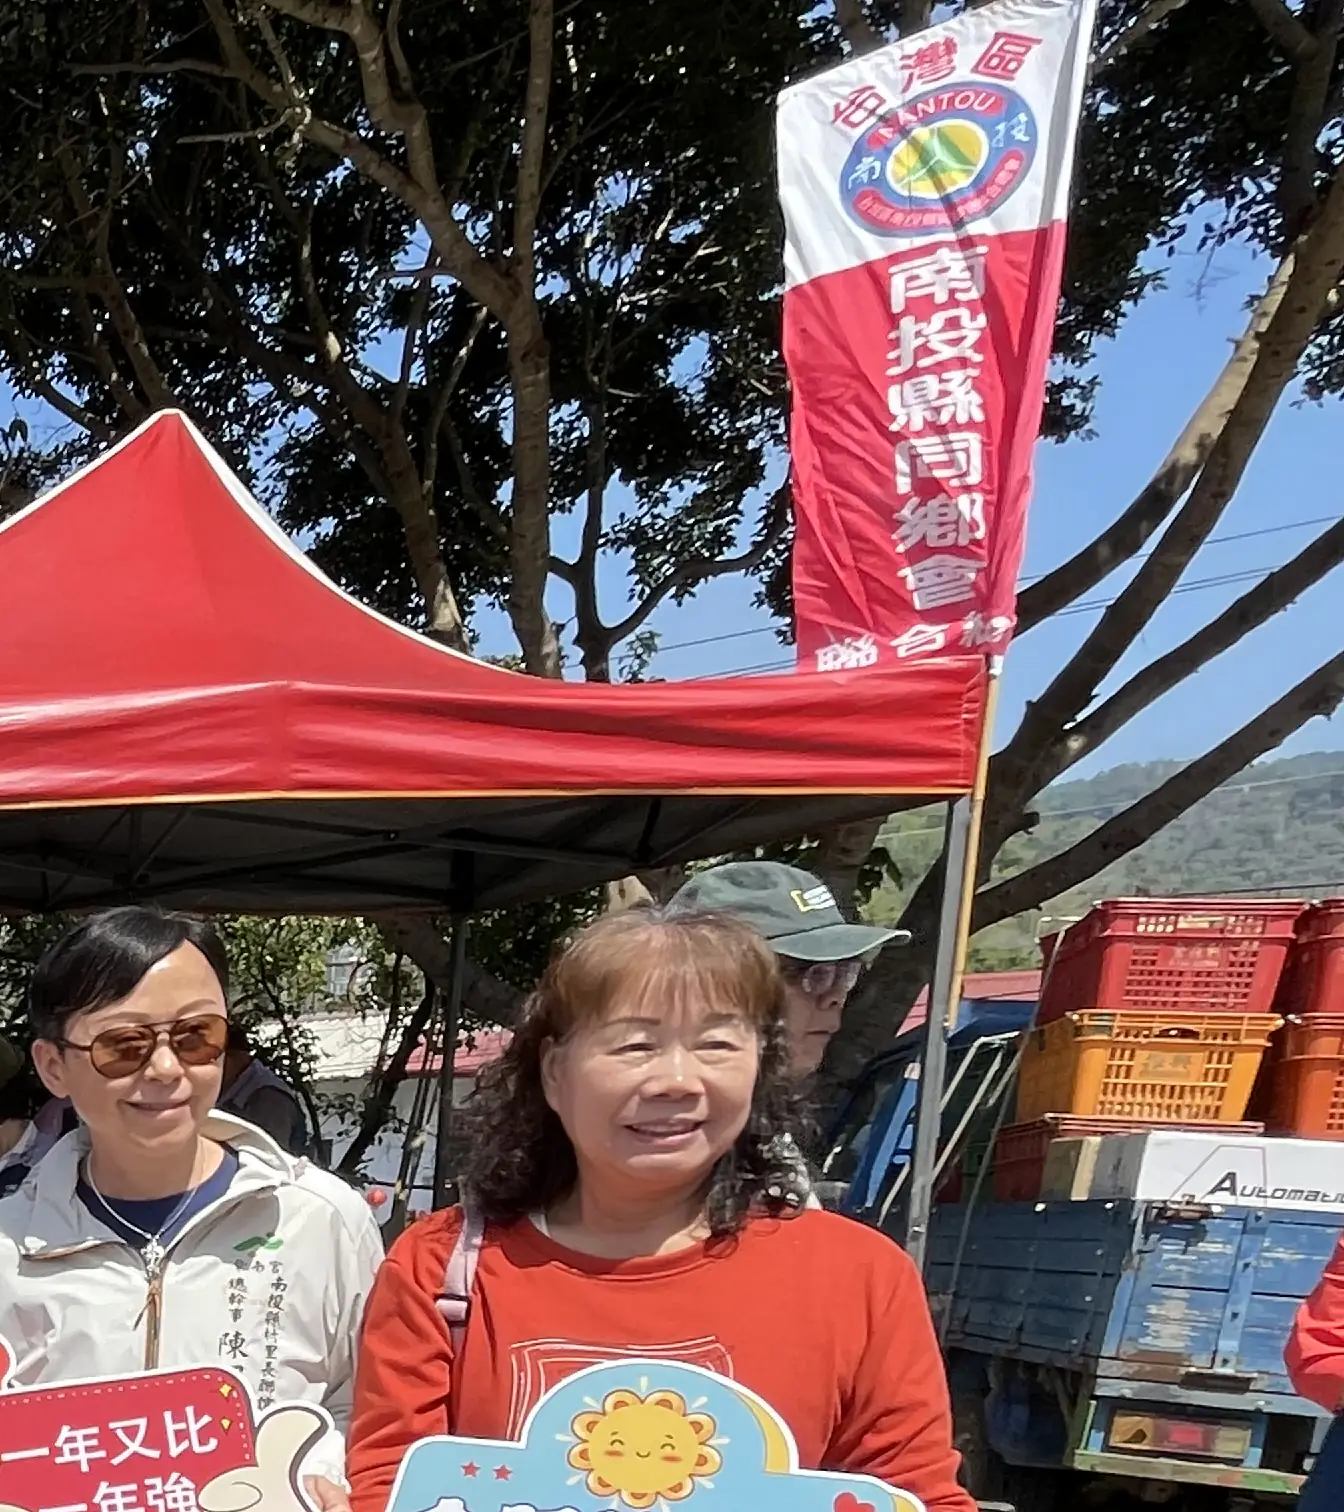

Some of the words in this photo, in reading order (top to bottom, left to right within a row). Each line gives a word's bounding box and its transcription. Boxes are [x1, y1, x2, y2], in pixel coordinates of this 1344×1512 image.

[831, 31, 1043, 129] 台灣區
[885, 245, 989, 610] 南投縣同鄉會
[1207, 1171, 1344, 1204] Automati
[218, 1331, 249, 1372] 陳
[1, 1405, 218, 1475] 一年又比
